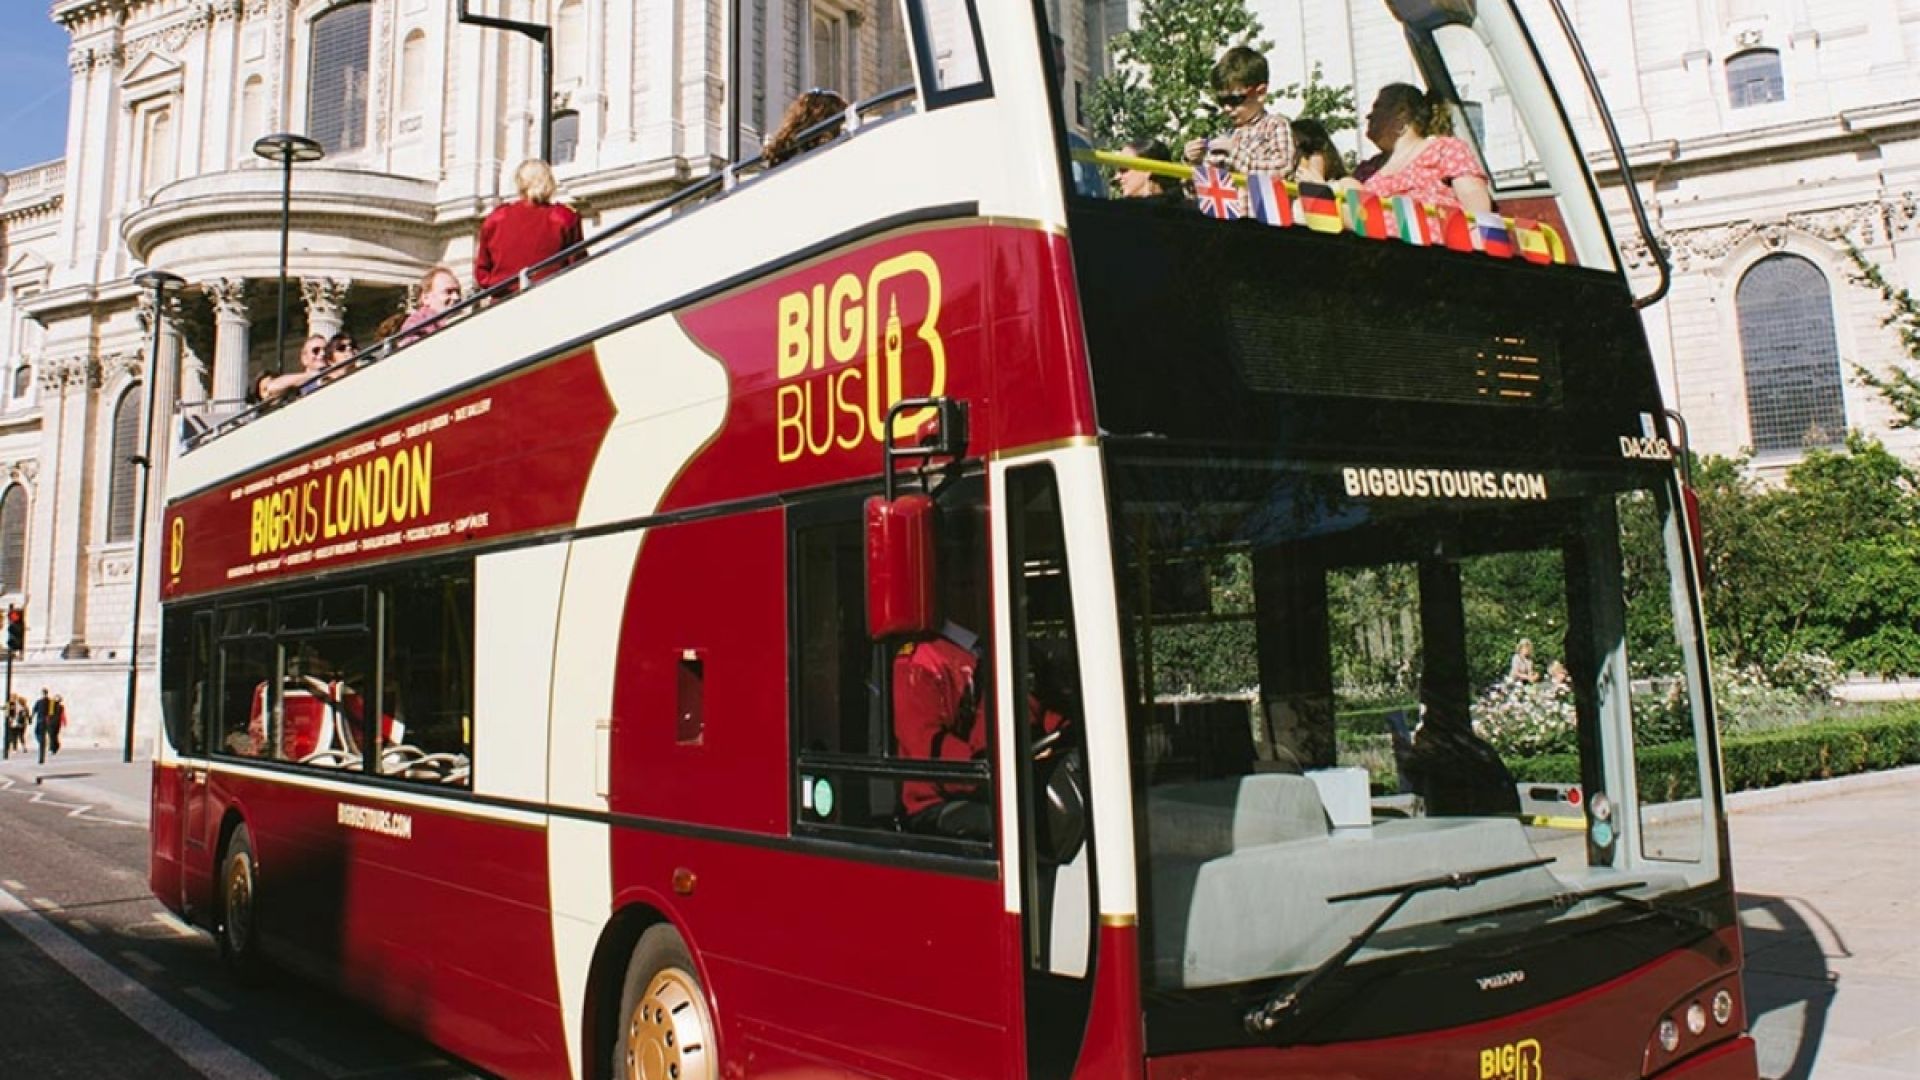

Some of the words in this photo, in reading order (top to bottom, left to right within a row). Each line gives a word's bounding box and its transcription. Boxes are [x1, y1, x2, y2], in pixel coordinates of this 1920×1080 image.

[778, 273, 864, 379] BIG
[778, 367, 865, 463] BUS
[1618, 435, 1672, 460] DA208
[324, 440, 432, 539] LONDON
[1343, 467, 1546, 500] BIGBUSTOURS.COM
[1481, 1043, 1514, 1079] BIG
